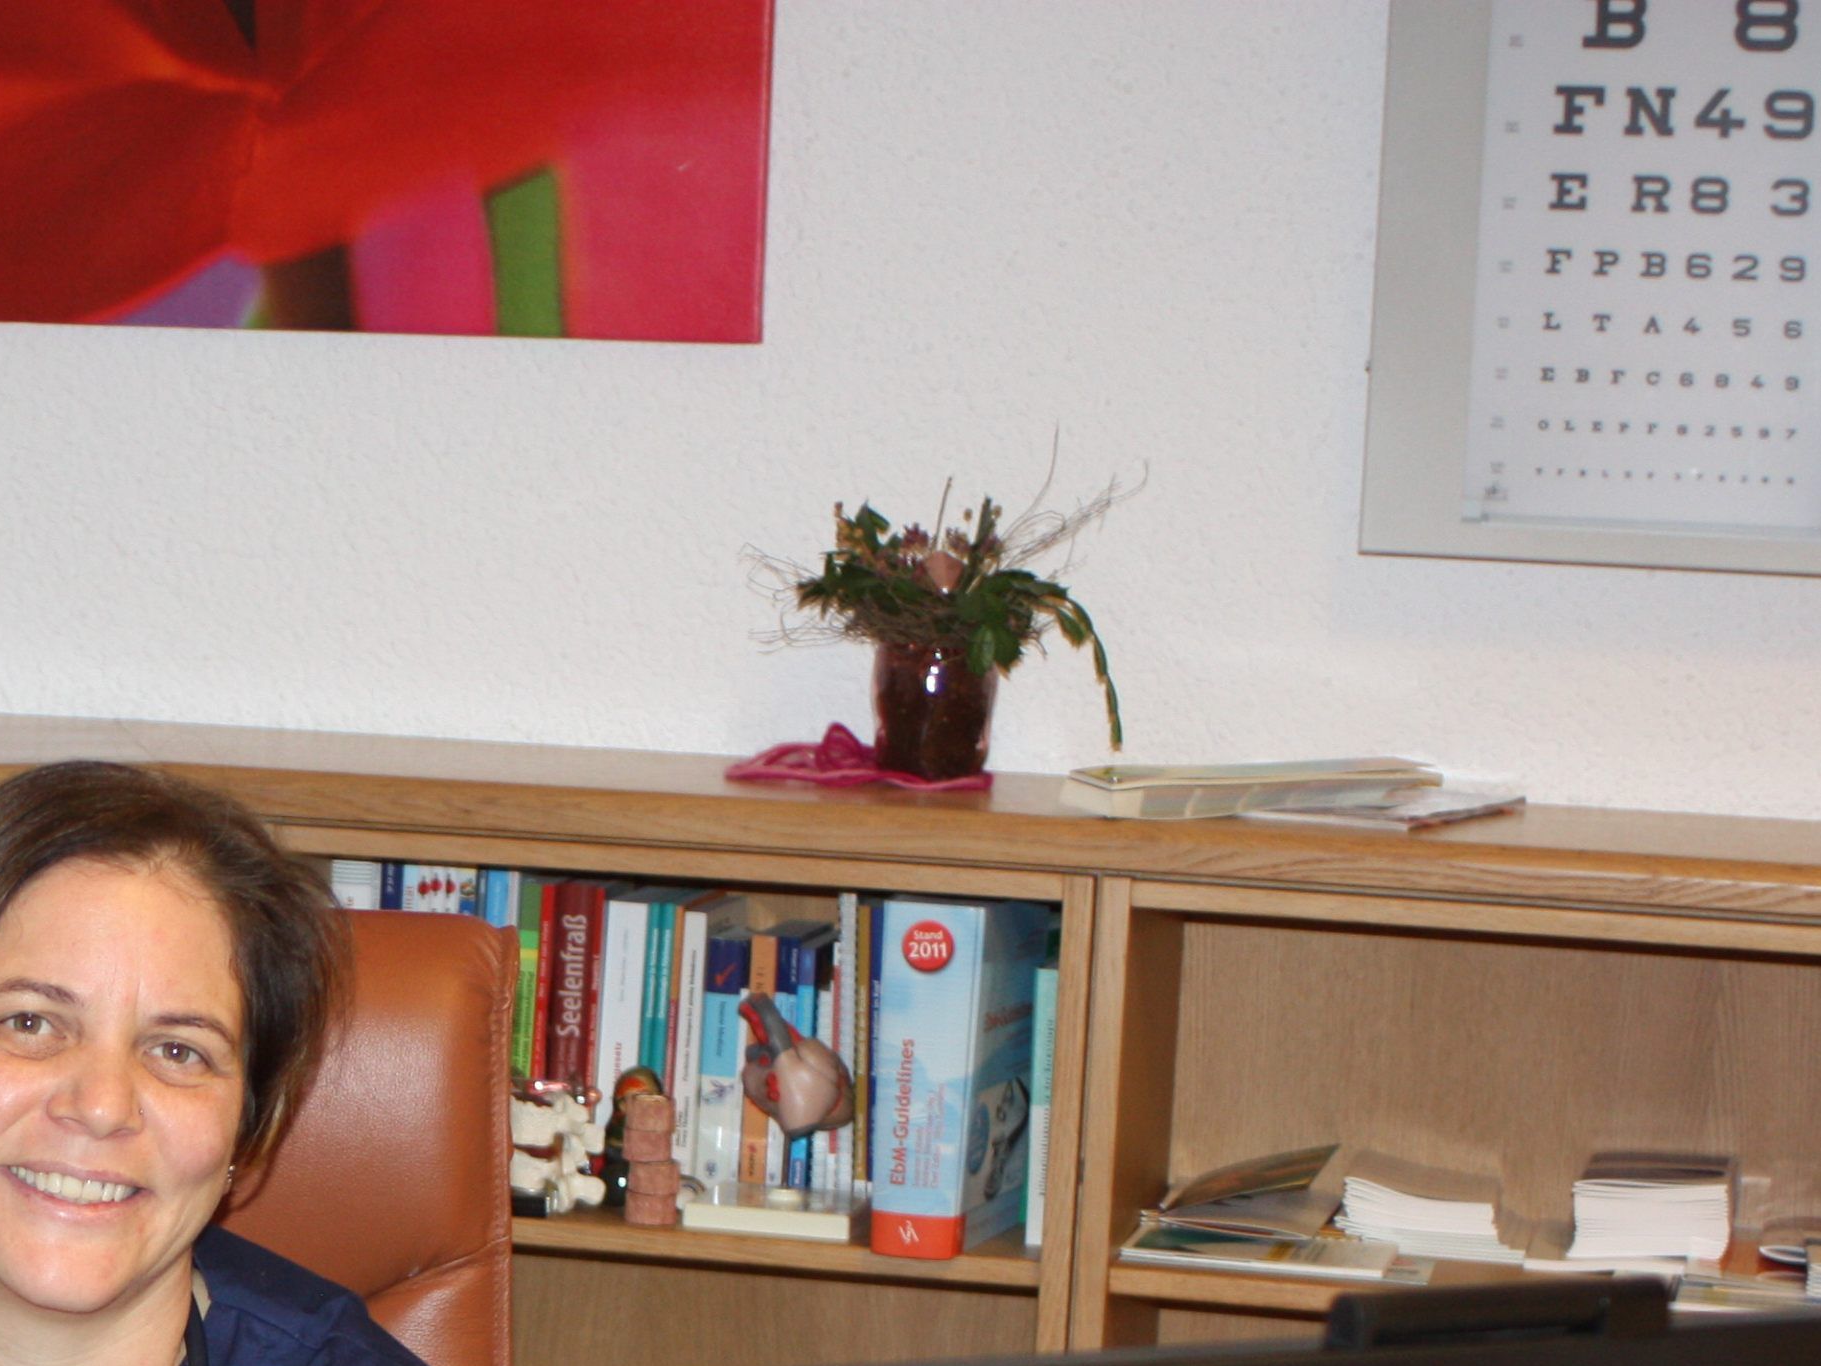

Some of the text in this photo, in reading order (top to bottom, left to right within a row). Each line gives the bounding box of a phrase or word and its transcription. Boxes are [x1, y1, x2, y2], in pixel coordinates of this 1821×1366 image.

[1581, 0, 1801, 53] B 8
[908, 942, 948, 959] 2011
[913, 930, 943, 941] Stand
[556, 914, 587, 1038] Seelenfraß
[890, 1039, 915, 1186] EbM-Guidelines
